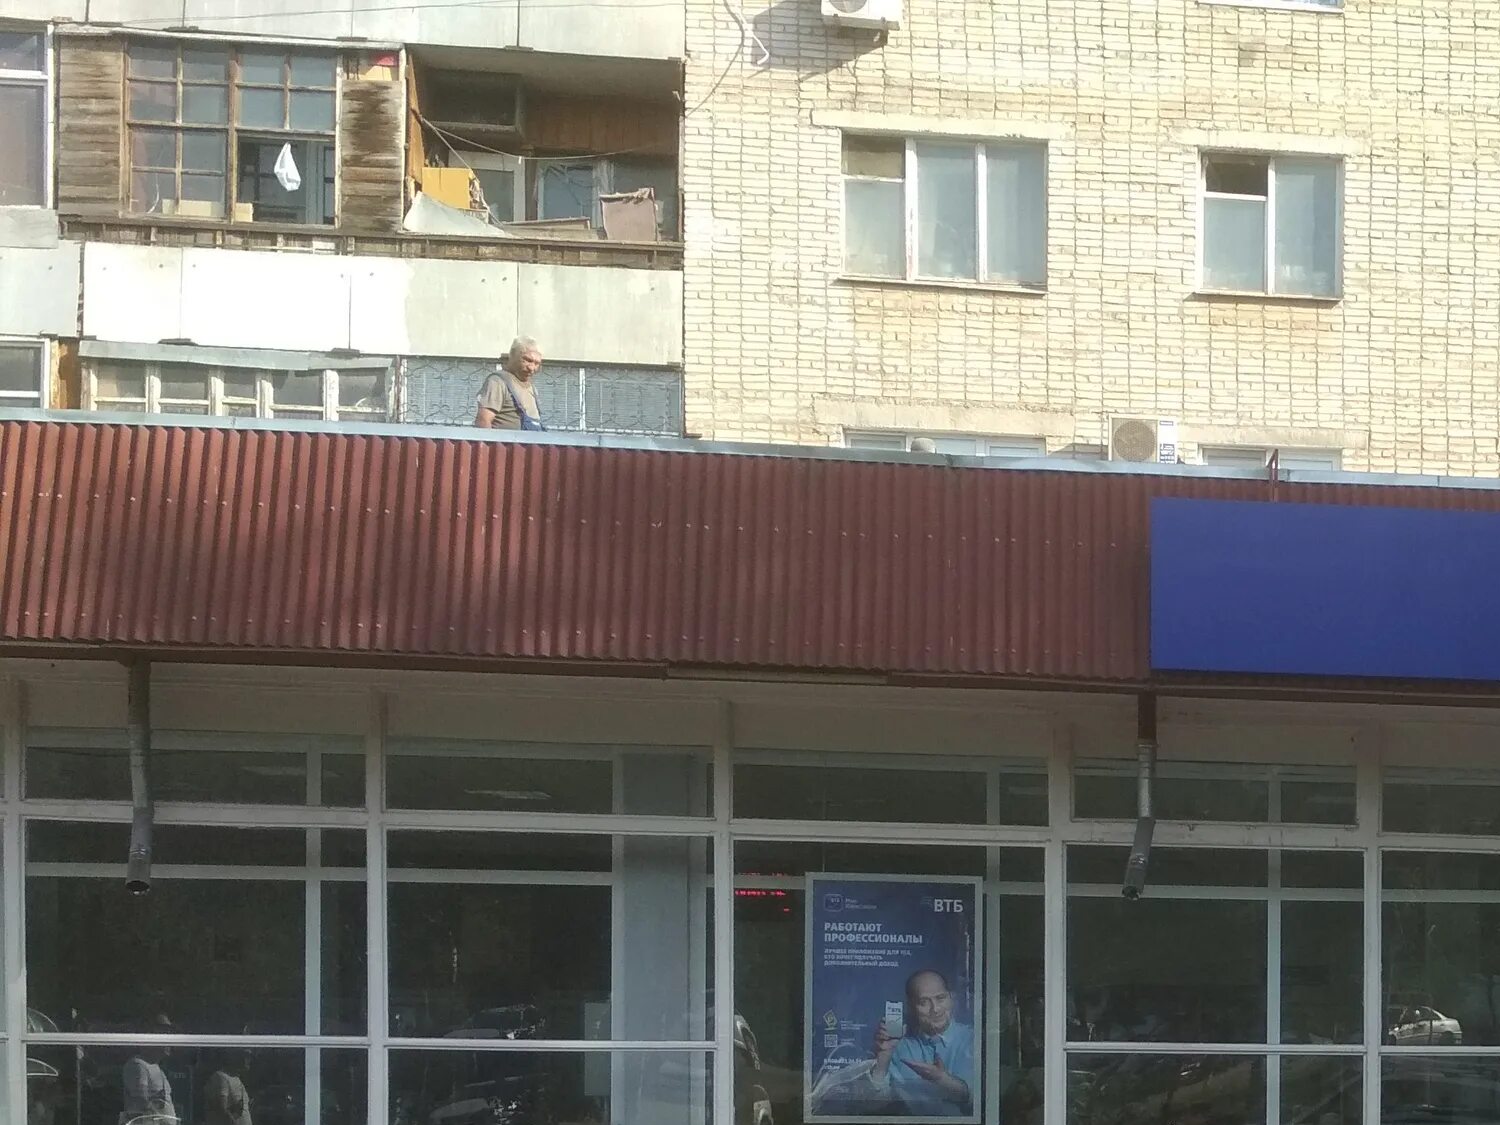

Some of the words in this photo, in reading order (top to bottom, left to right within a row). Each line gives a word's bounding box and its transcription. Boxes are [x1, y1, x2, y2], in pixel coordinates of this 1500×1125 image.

[933, 899, 964, 913] ВТБ
[824, 922, 882, 932] РАБОТАЮТ
[824, 933, 923, 944] ПРОФЕССИОНАЛЫ
